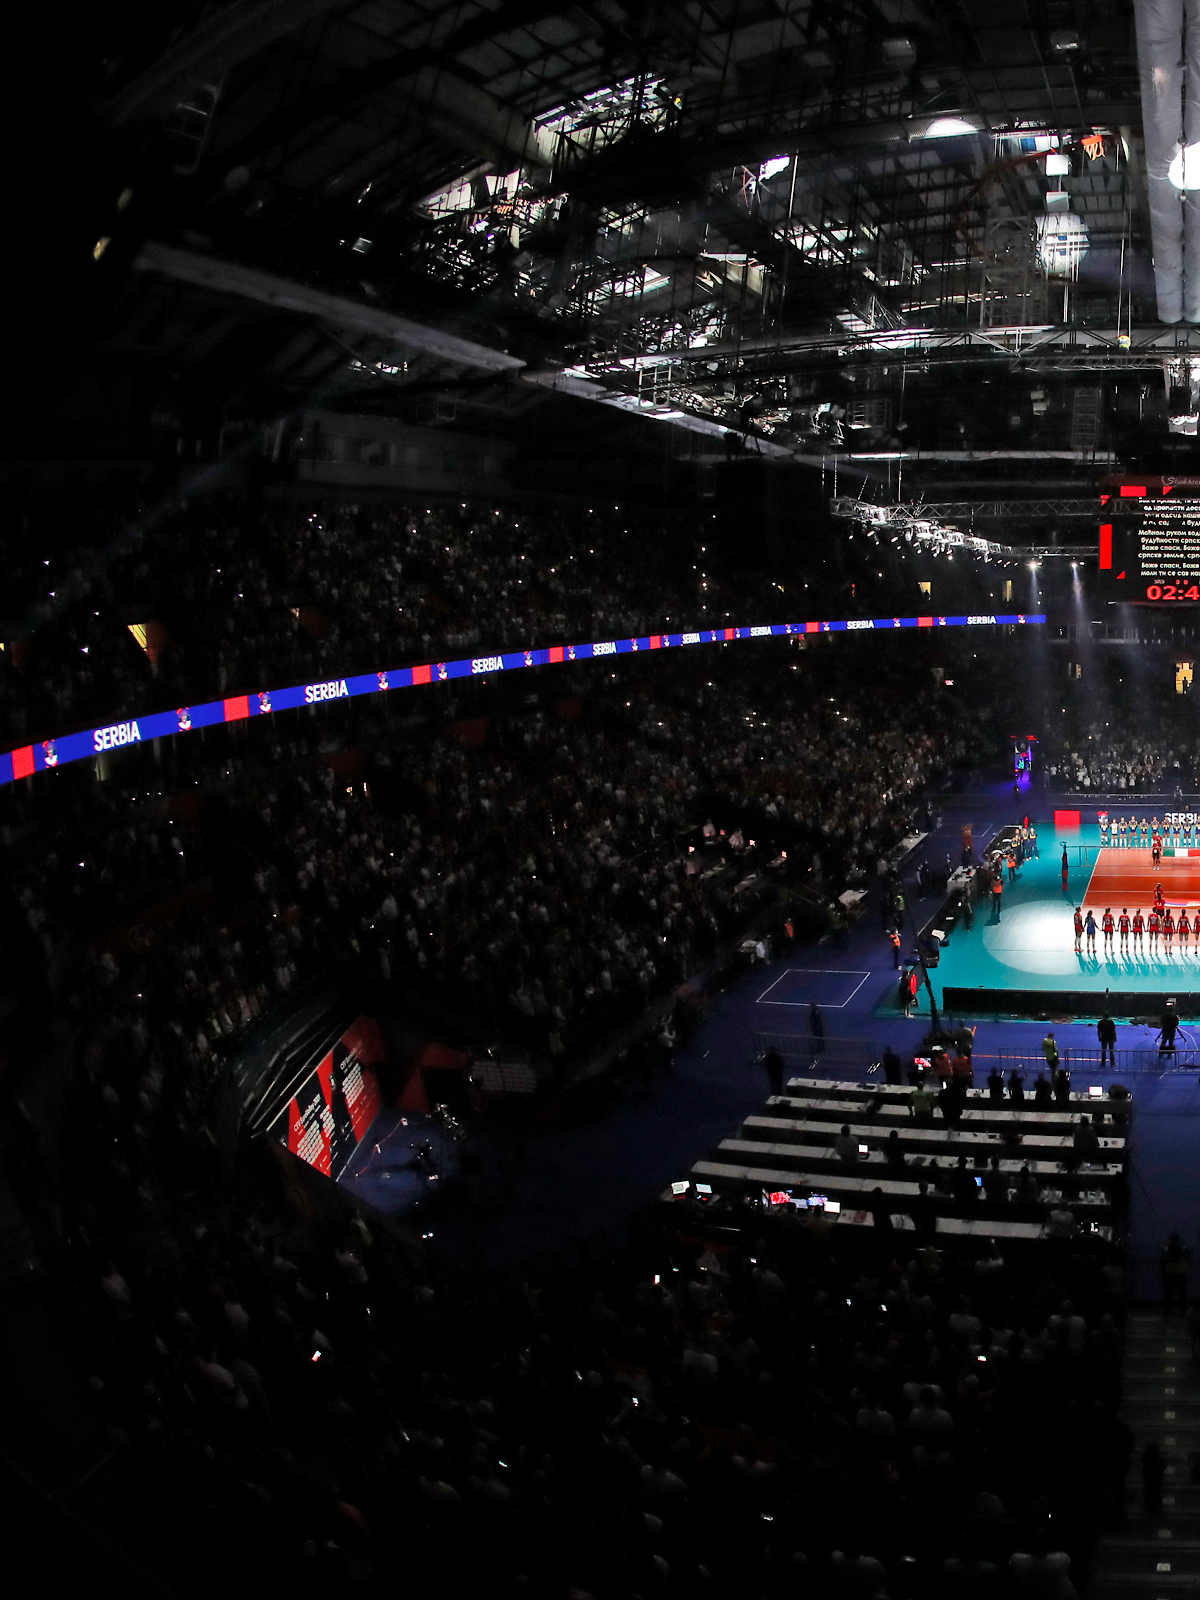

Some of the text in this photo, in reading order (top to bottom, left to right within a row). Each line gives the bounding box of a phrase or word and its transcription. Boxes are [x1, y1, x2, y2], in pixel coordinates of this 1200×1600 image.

[847, 620, 874, 629] SERBIA
[967, 616, 997, 625] SERBIA
[750, 626, 772, 636] SERBIA
[682, 633, 700, 645] SERBIA
[592, 642, 616, 656] SERBIA
[472, 656, 504, 673] SERBIA
[305, 680, 349, 703] SERBIA
[94, 721, 141, 751] SERBIA
